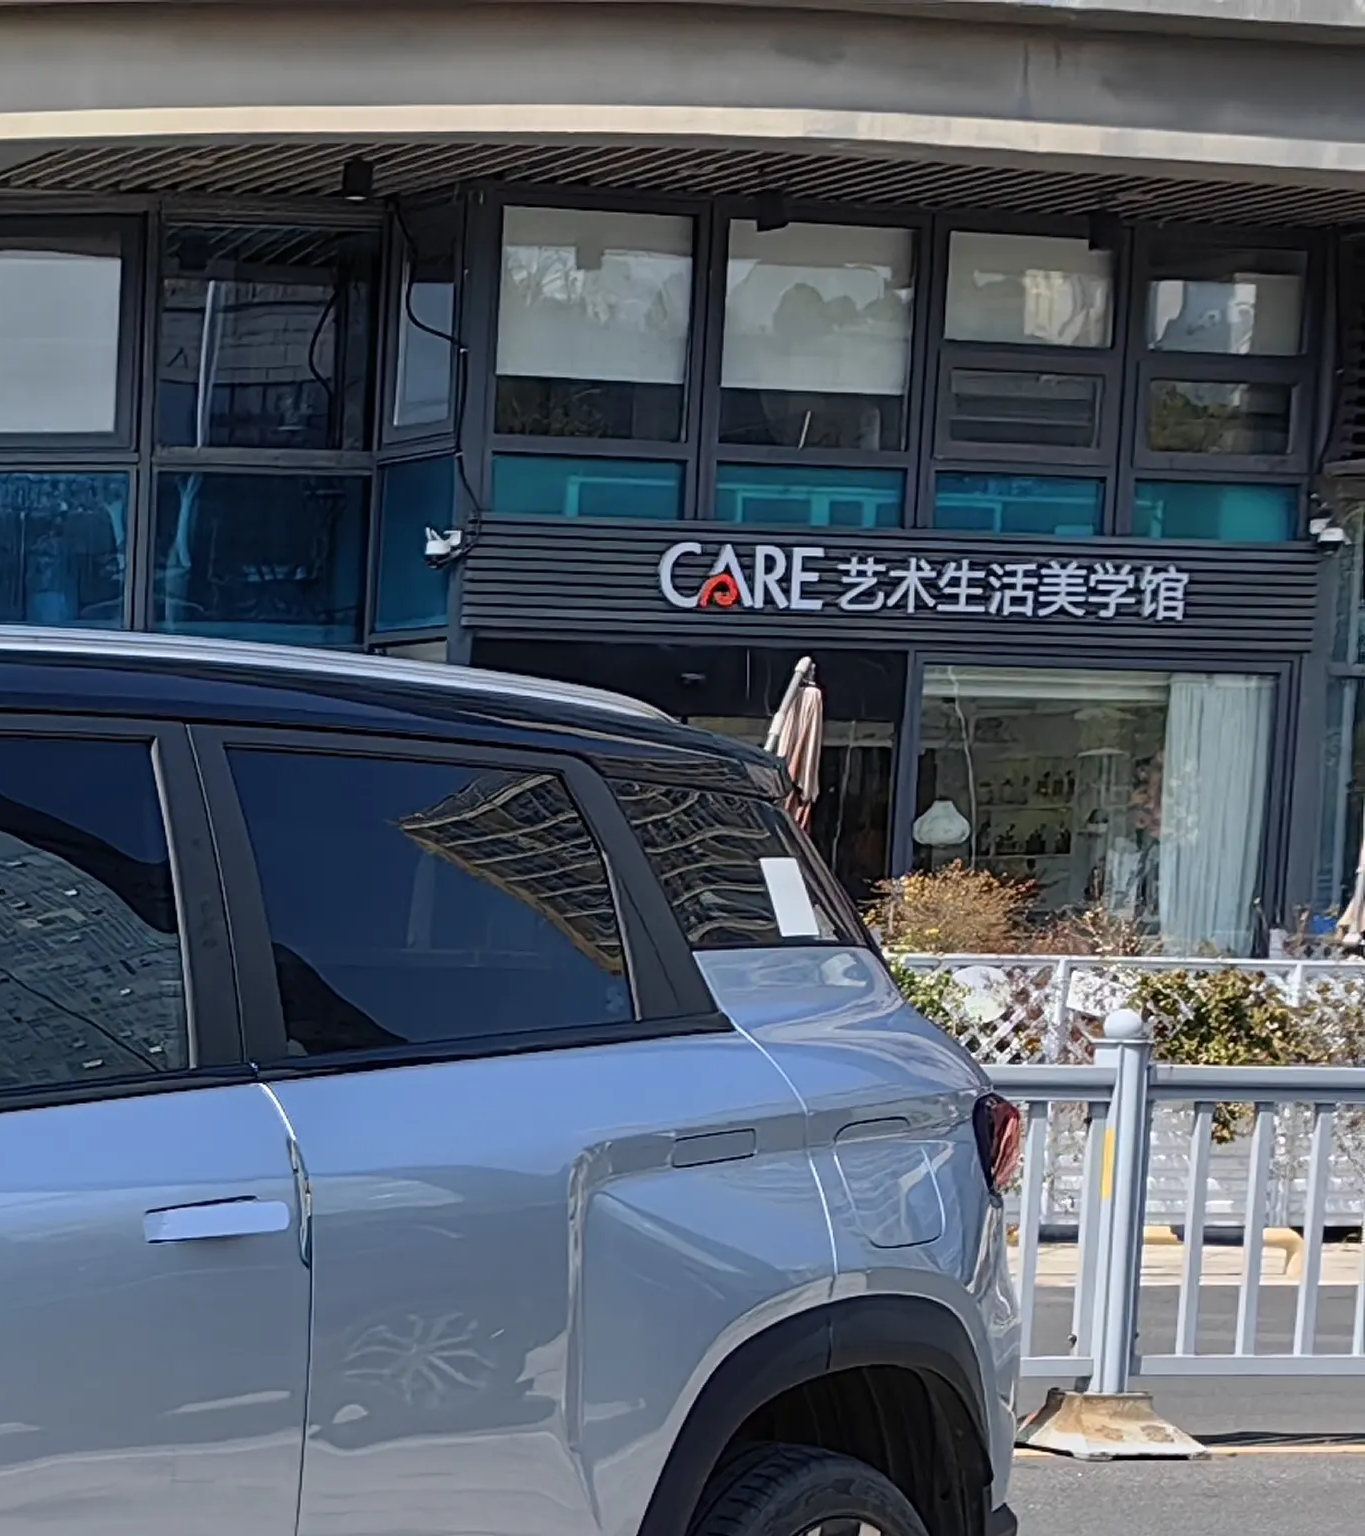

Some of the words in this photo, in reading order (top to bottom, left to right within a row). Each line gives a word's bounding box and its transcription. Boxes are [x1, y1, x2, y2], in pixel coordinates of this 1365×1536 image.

[657, 541, 825, 611] CARE
[837, 556, 1190, 622] 艺术生活美学馆
